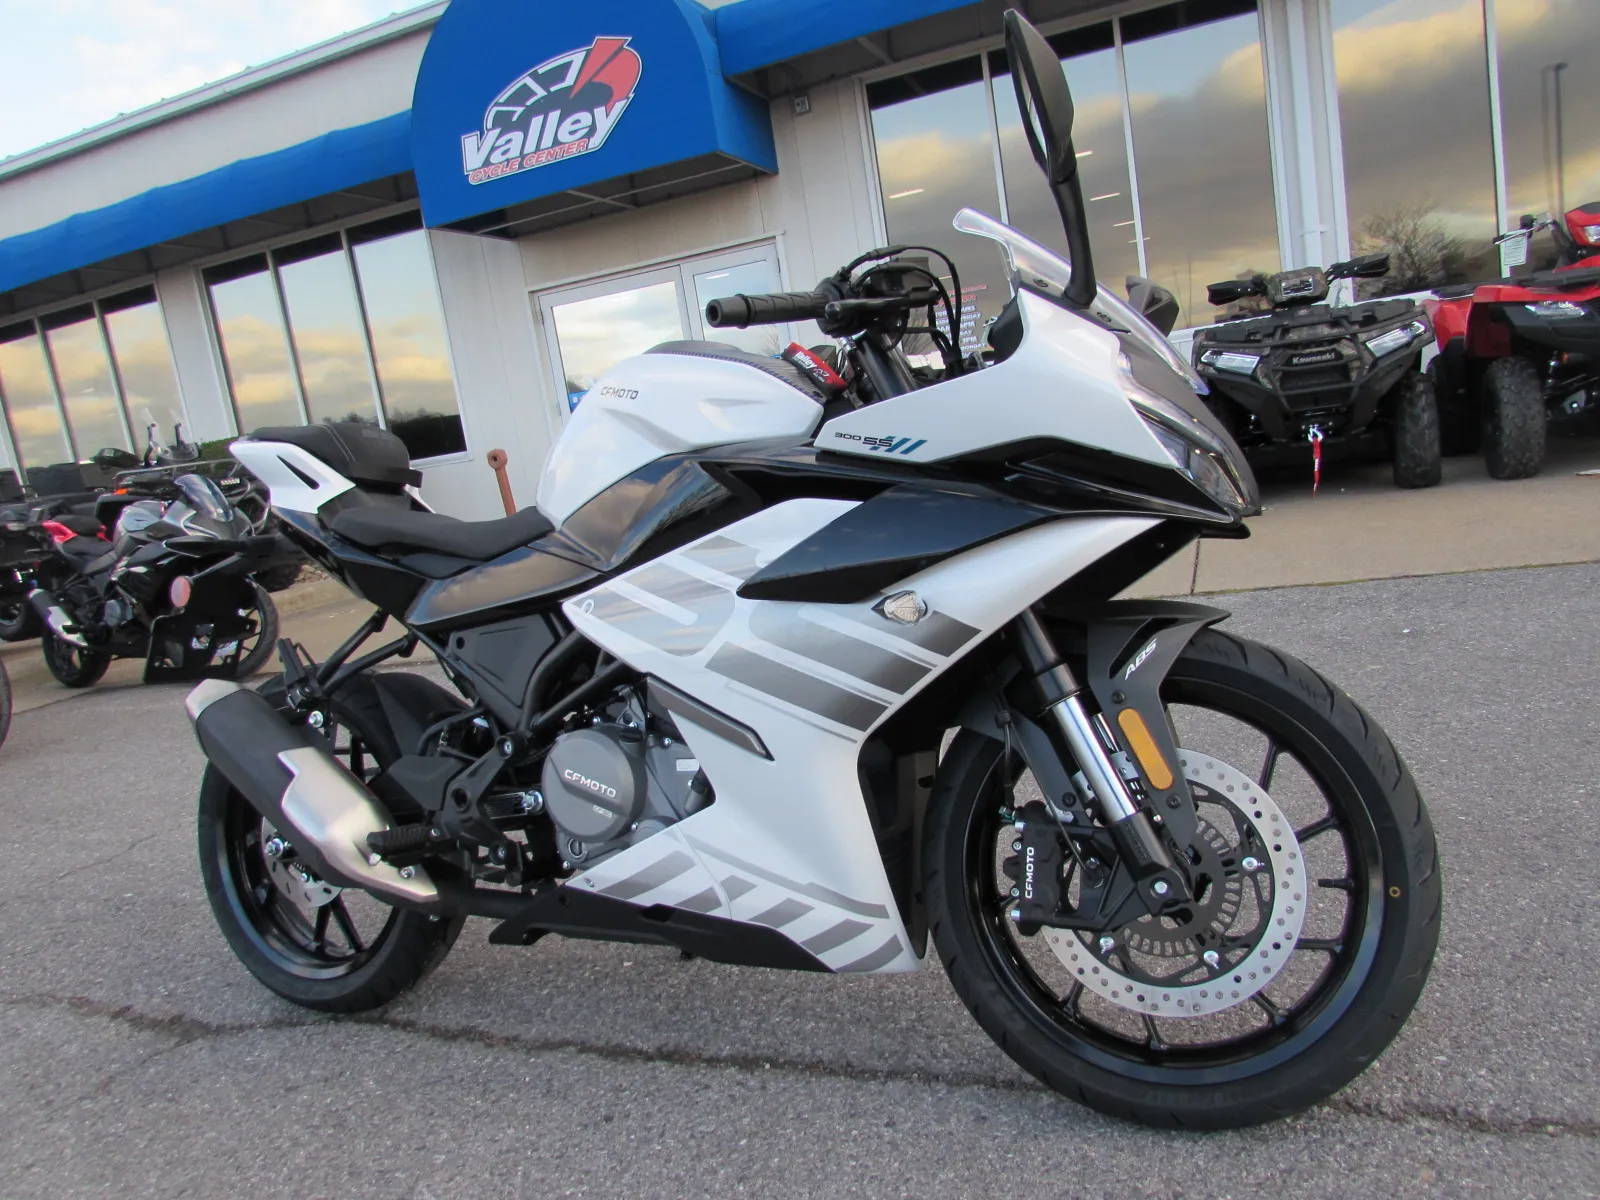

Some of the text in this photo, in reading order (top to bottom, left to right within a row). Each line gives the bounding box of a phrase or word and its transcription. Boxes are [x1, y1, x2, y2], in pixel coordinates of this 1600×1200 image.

[463, 99, 628, 171] Valley
[469, 138, 589, 182] CYCLE CENTER
[1292, 352, 1335, 365] Kawasaki
[600, 386, 640, 400] CFMOTO
[834, 431, 862, 441] 300
[1124, 637, 1157, 681] ABS
[564, 769, 617, 798] CFMOTO
[1025, 846, 1035, 899] CFMOTO
